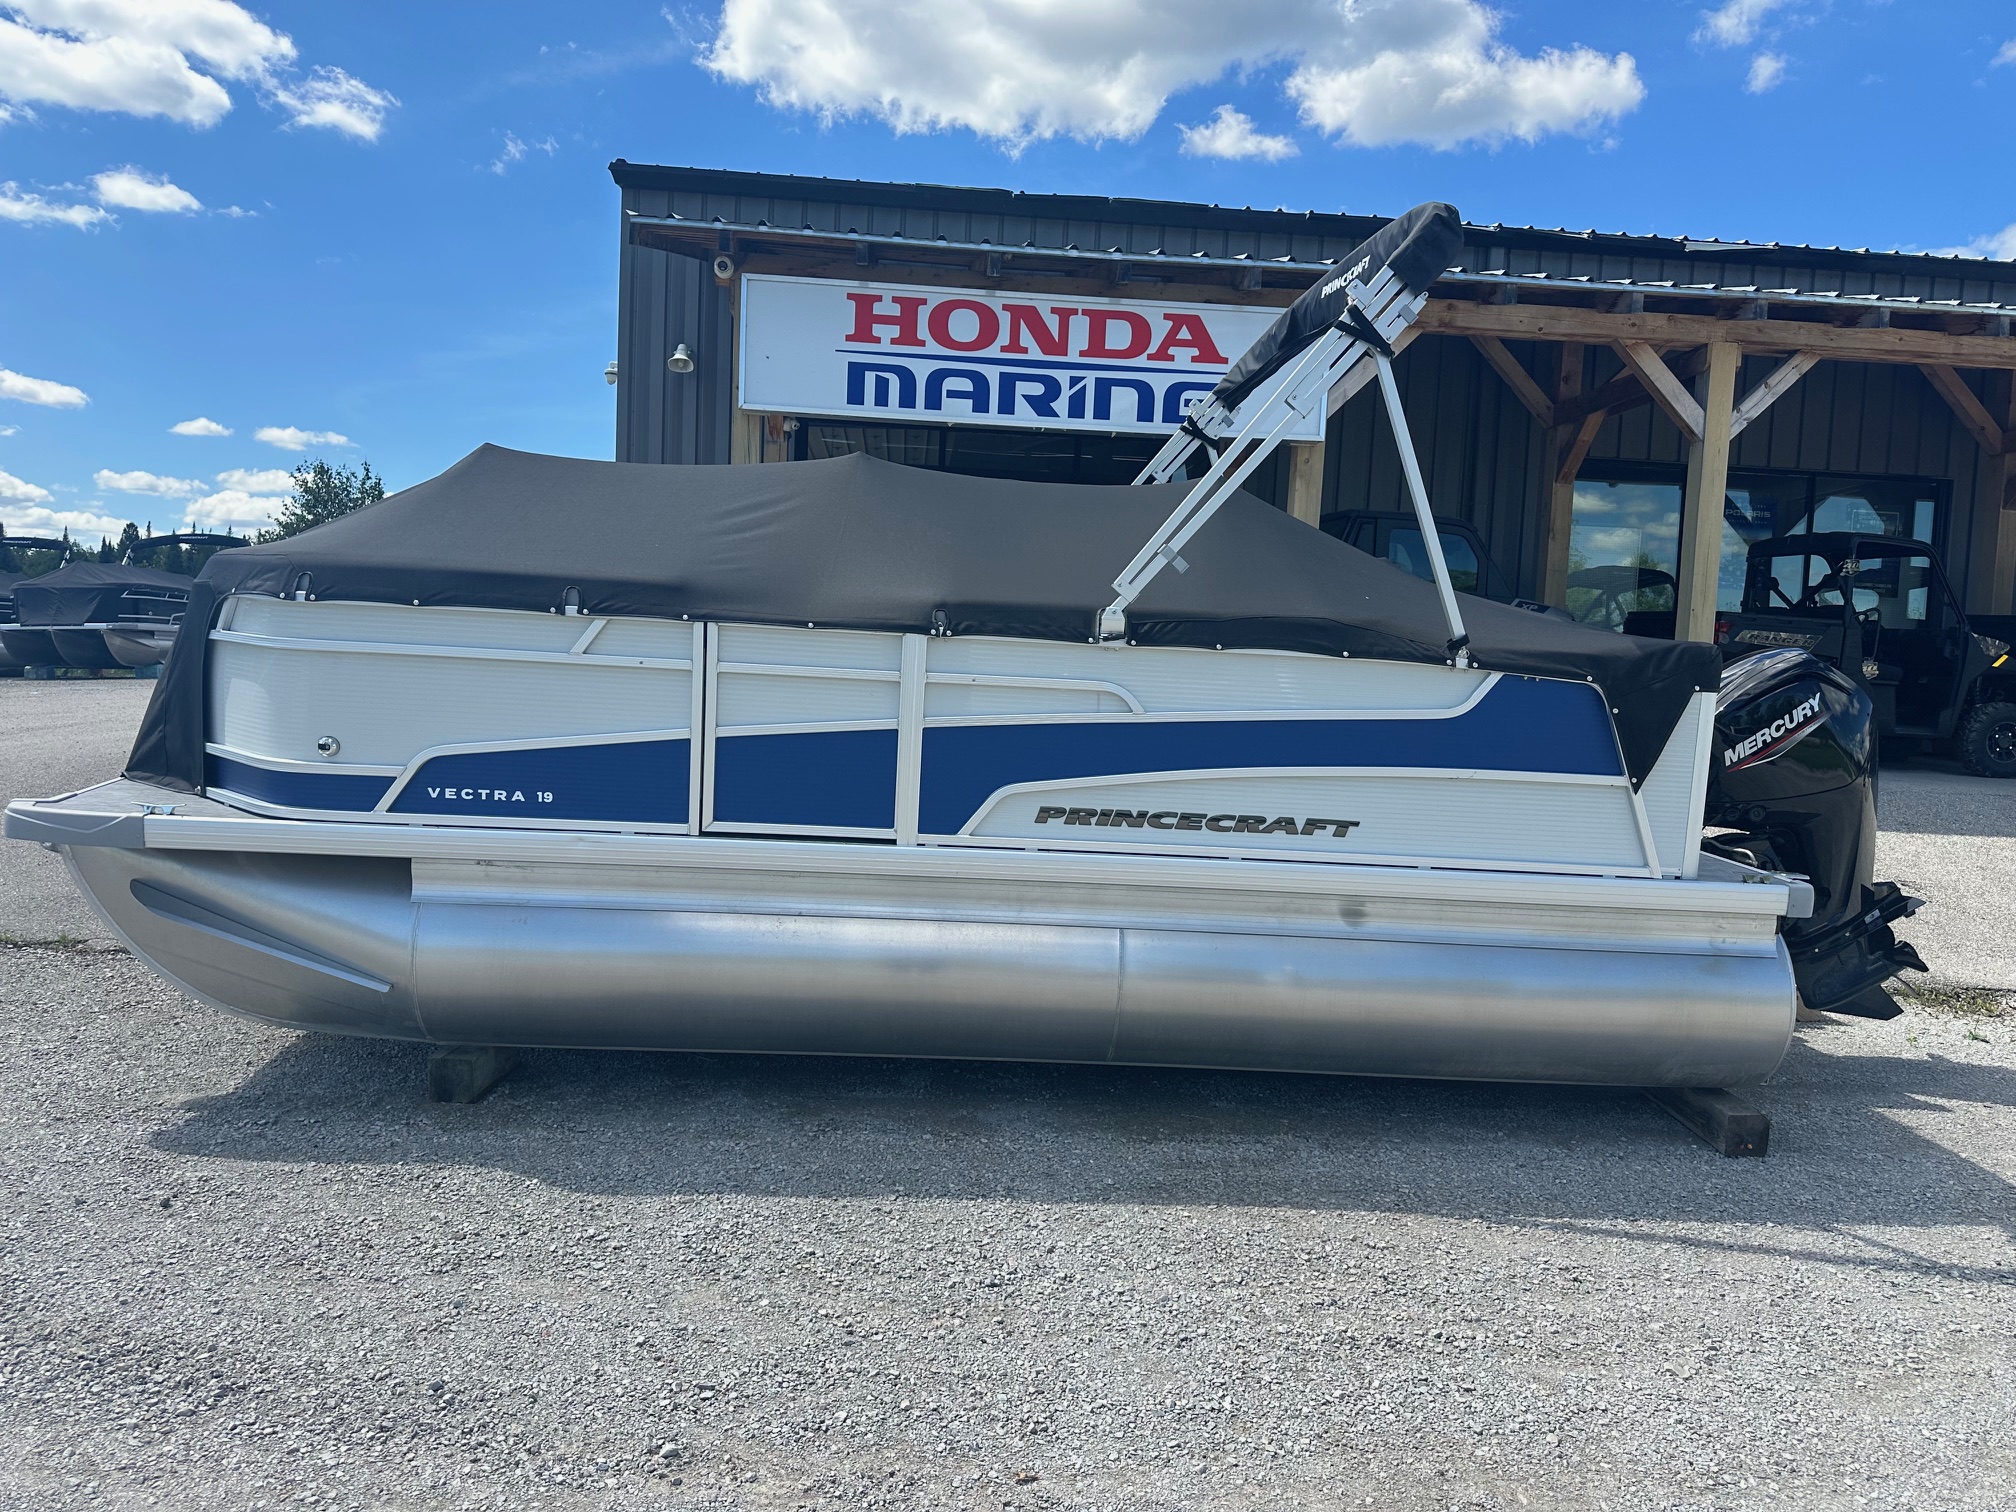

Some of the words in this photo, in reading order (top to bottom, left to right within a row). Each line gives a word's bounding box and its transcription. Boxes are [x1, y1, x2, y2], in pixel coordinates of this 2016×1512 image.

[845, 292, 1229, 365] HONDA
[846, 361, 1219, 425] MARINE
[1747, 633, 1816, 647] RANGER
[1723, 692, 1821, 767] MERCURY
[427, 787, 526, 802] VECTRA
[536, 791, 553, 803] 19
[1034, 806, 1360, 838] PRINCECRAFT
